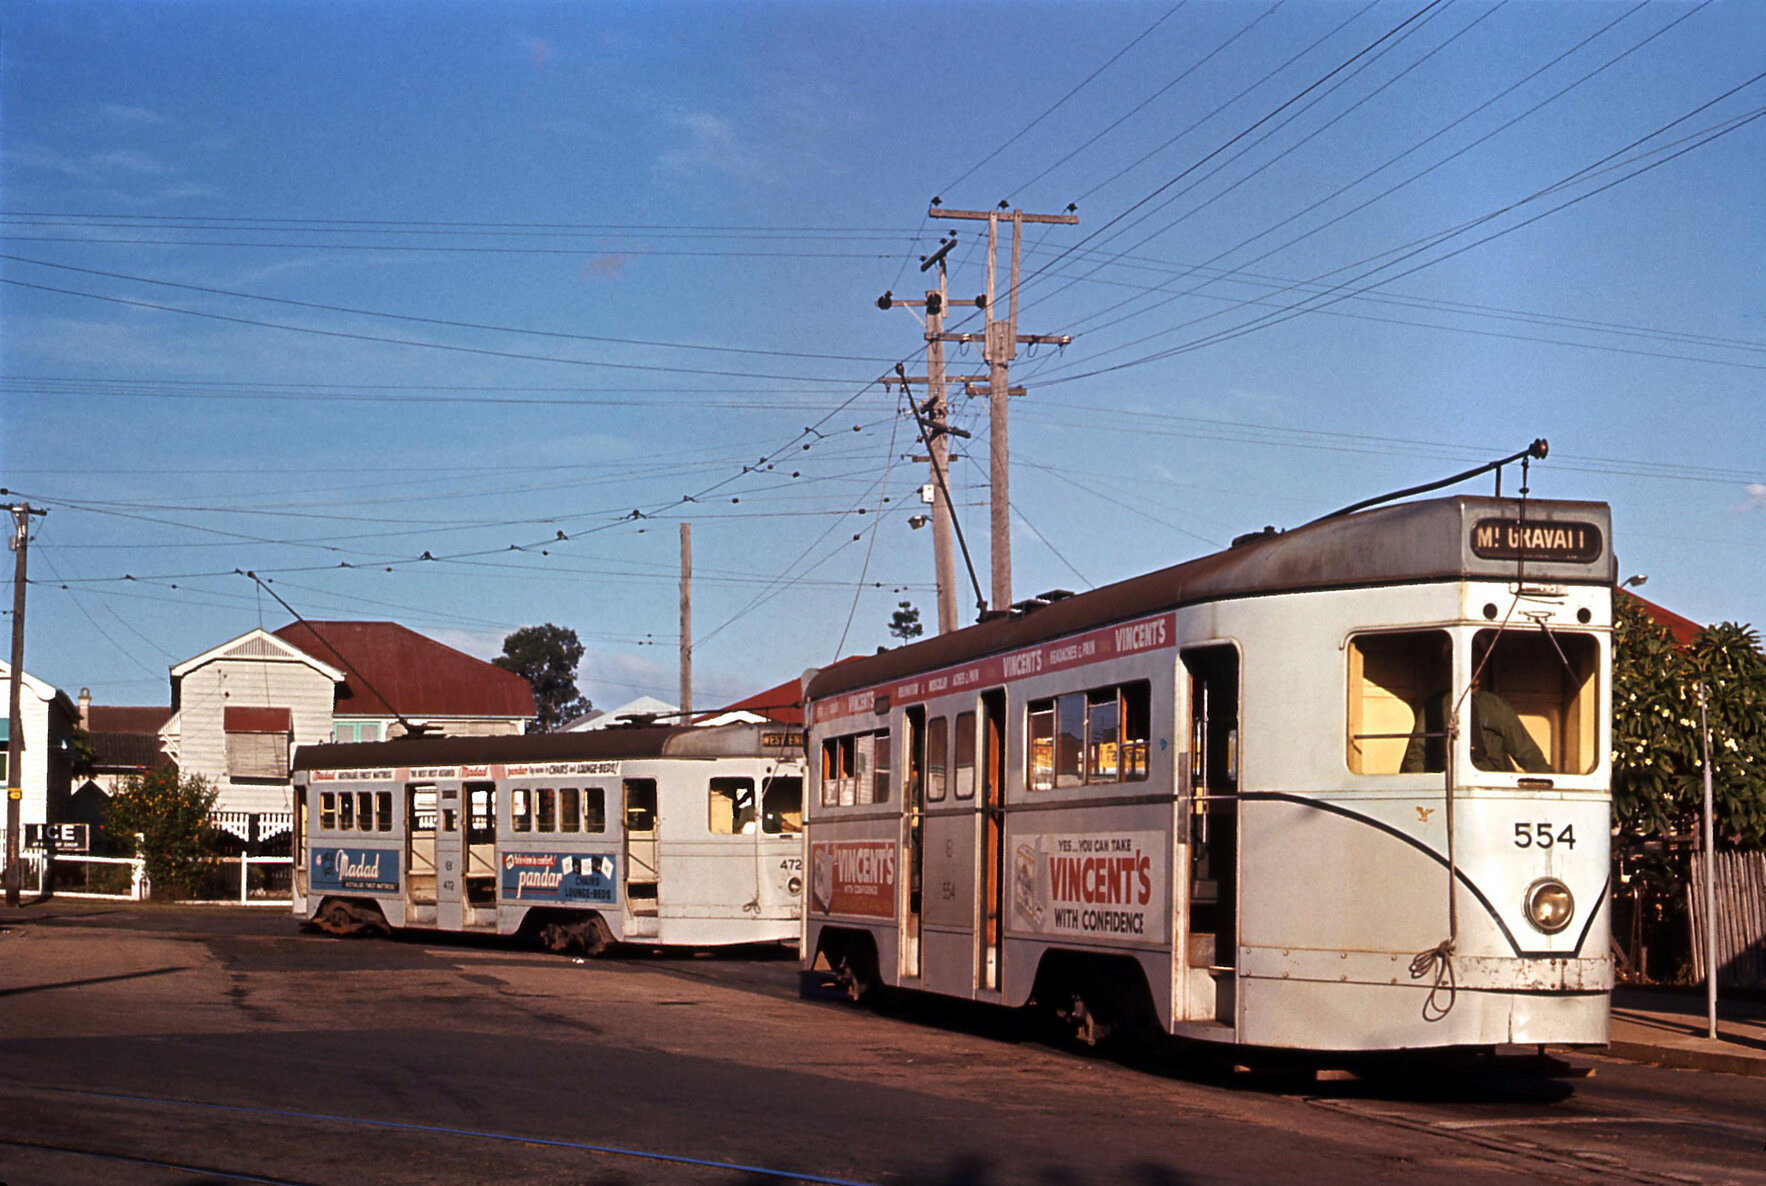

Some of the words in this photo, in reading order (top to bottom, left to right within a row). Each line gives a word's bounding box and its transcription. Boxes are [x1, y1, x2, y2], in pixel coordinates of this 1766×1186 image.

[549, 763, 569, 775] CHAIRS
[37, 824, 75, 840] ICE
[1514, 822, 1576, 850] 554
[1094, 840, 1109, 851] CAN
[1111, 839, 1132, 851] TAKE
[335, 849, 379, 881] Madad
[780, 859, 802, 870] 472
[838, 842, 895, 885] VINCENT'S
[442, 881, 455, 891] 472
[516, 866, 563, 900] pandar
[575, 876, 600, 886] CHAIRS
[1050, 849, 1151, 906] VINCENT'S
[1055, 909, 1079, 929] WITH
[1082, 911, 1144, 934] CONFIDENCE
